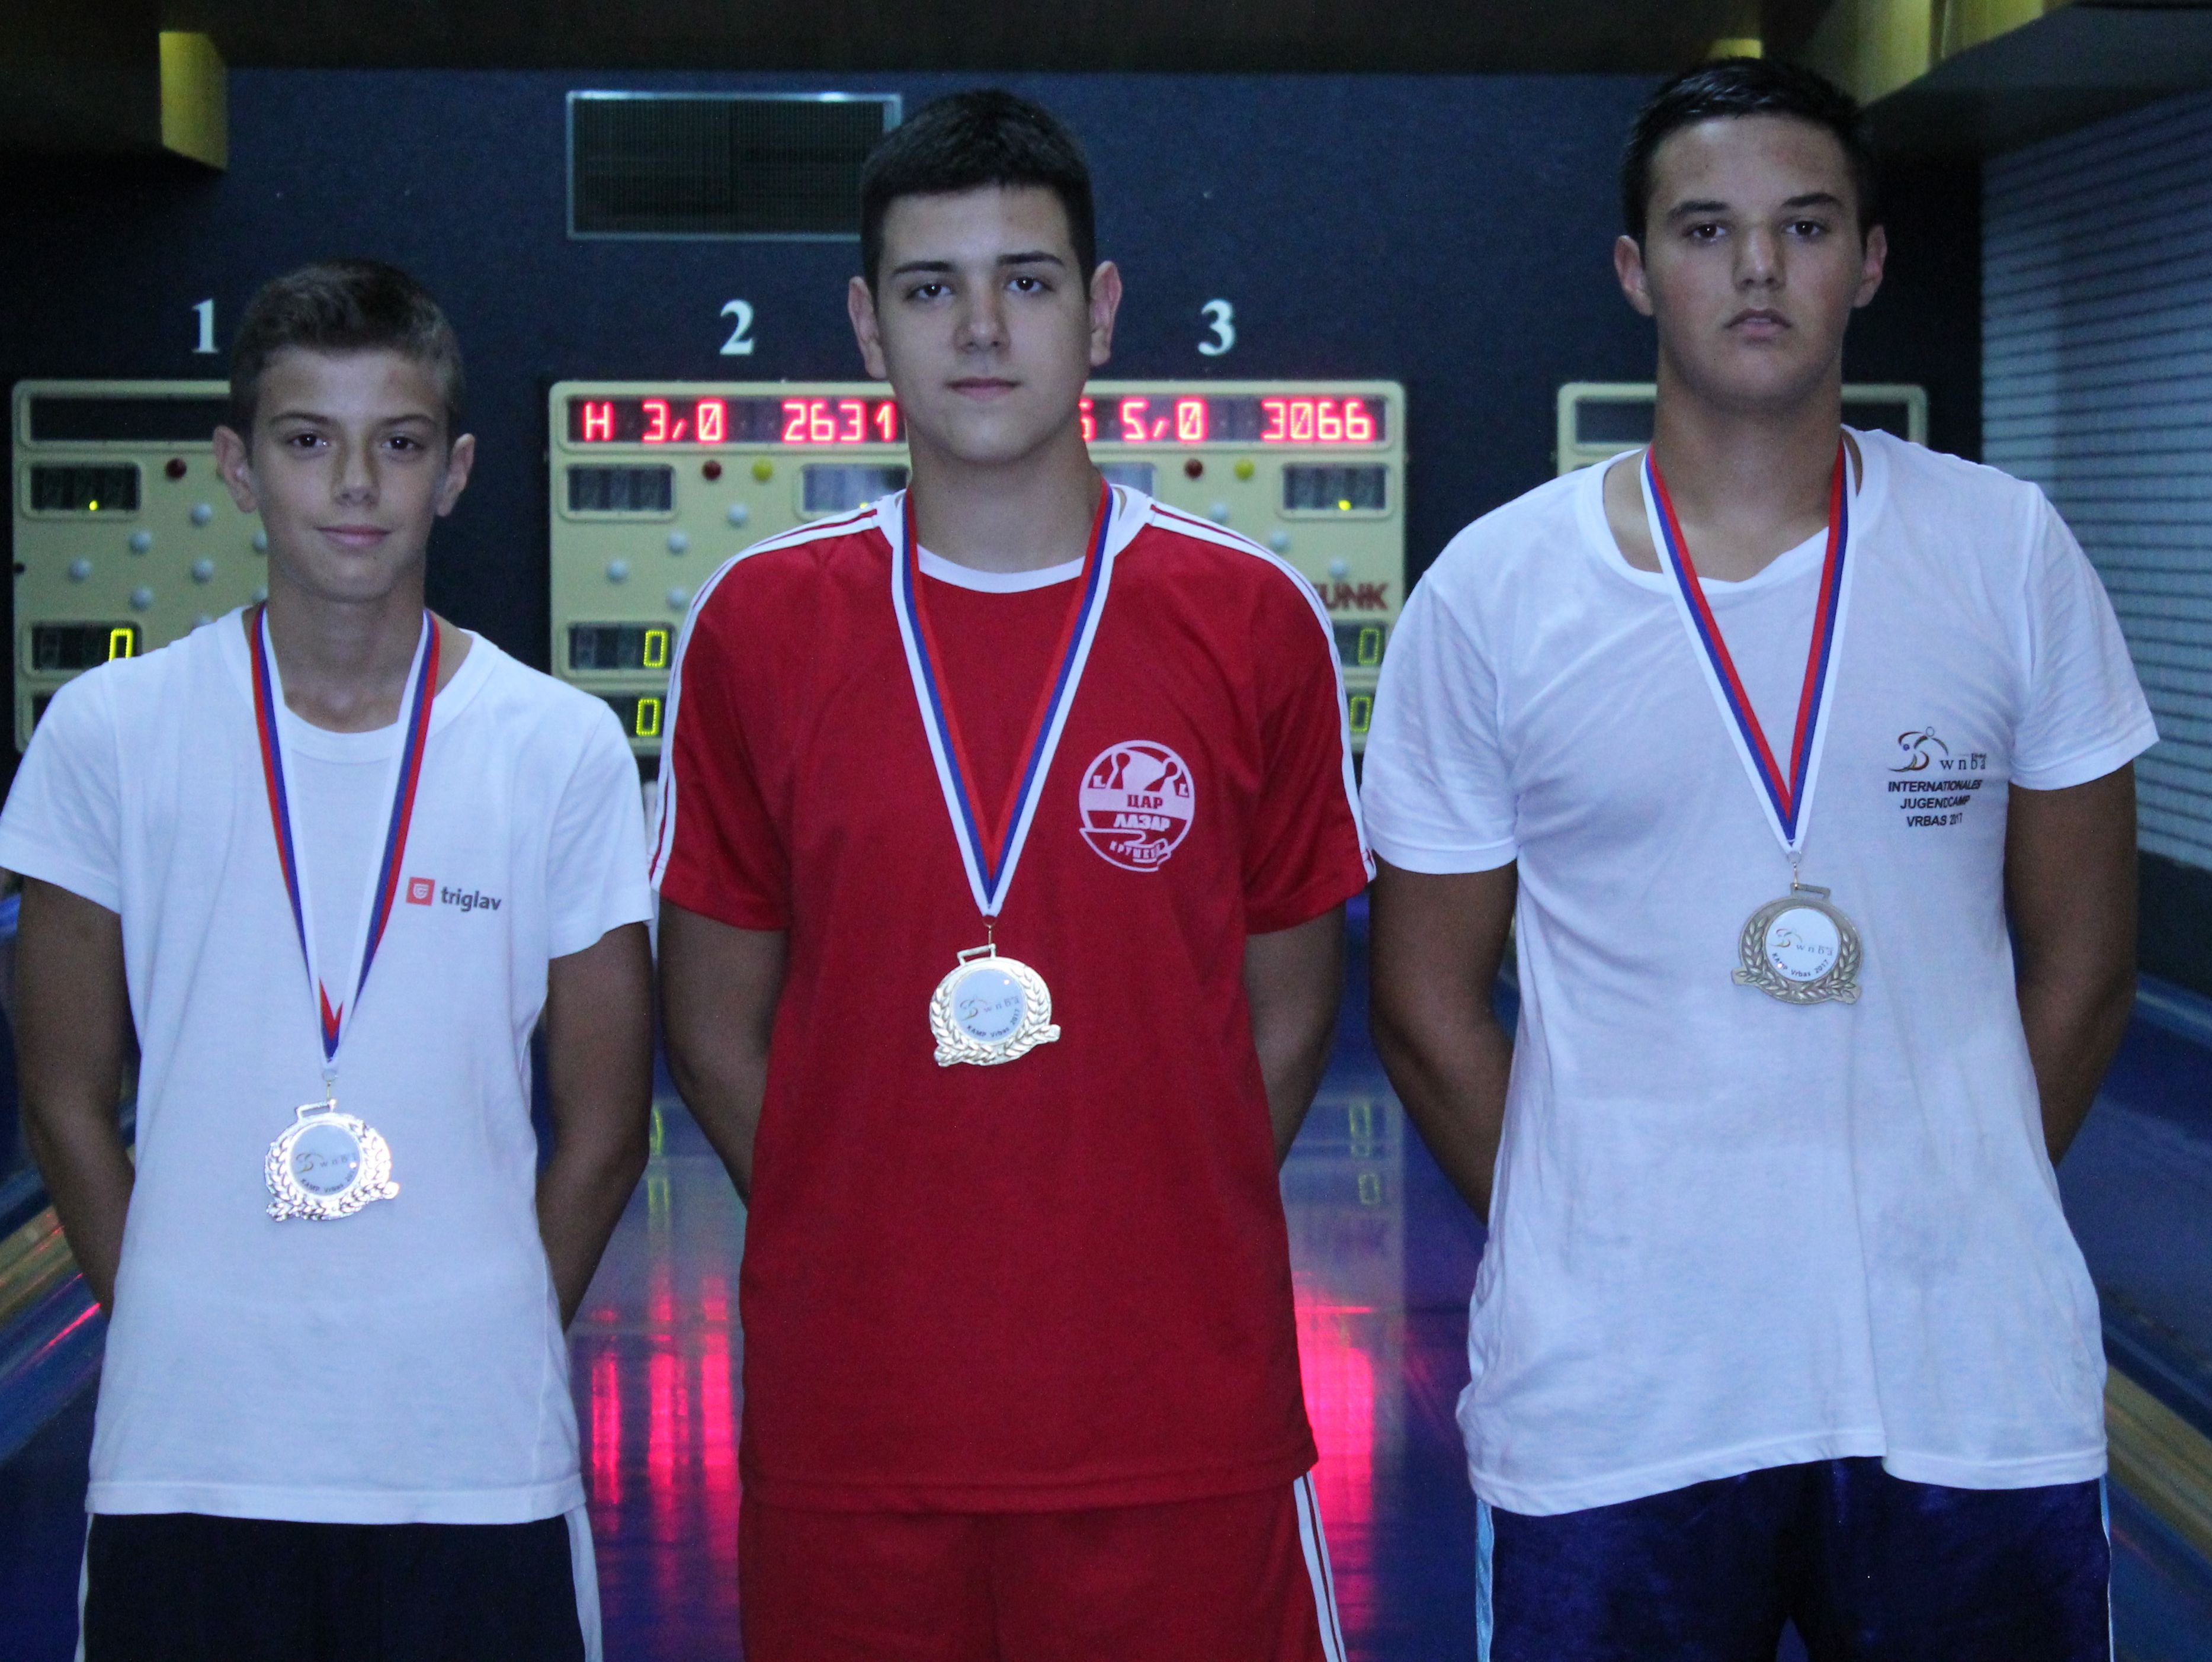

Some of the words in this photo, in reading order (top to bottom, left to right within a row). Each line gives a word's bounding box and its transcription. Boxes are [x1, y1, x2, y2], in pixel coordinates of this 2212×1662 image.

[192, 299, 219, 354] 1
[720, 299, 754, 355] 2
[1197, 299, 1235, 355] 3
[583, 401, 613, 441] H
[782, 399, 896, 443] 2631
[1262, 398, 1375, 443] 3066
[1314, 583, 1388, 610] UNK
[643, 629, 666, 668] 0
[1358, 628, 1380, 665] 0
[636, 698, 660, 736] 0
[1349, 696, 1371, 732] 0
[1127, 794, 1163, 809] ЦАР
[1113, 813, 1171, 832] ЛАЗАР
[1906, 814, 1947, 827] VRBAS
[441, 886, 502, 913] triglav
[1814, 959, 1829, 974] 2017
